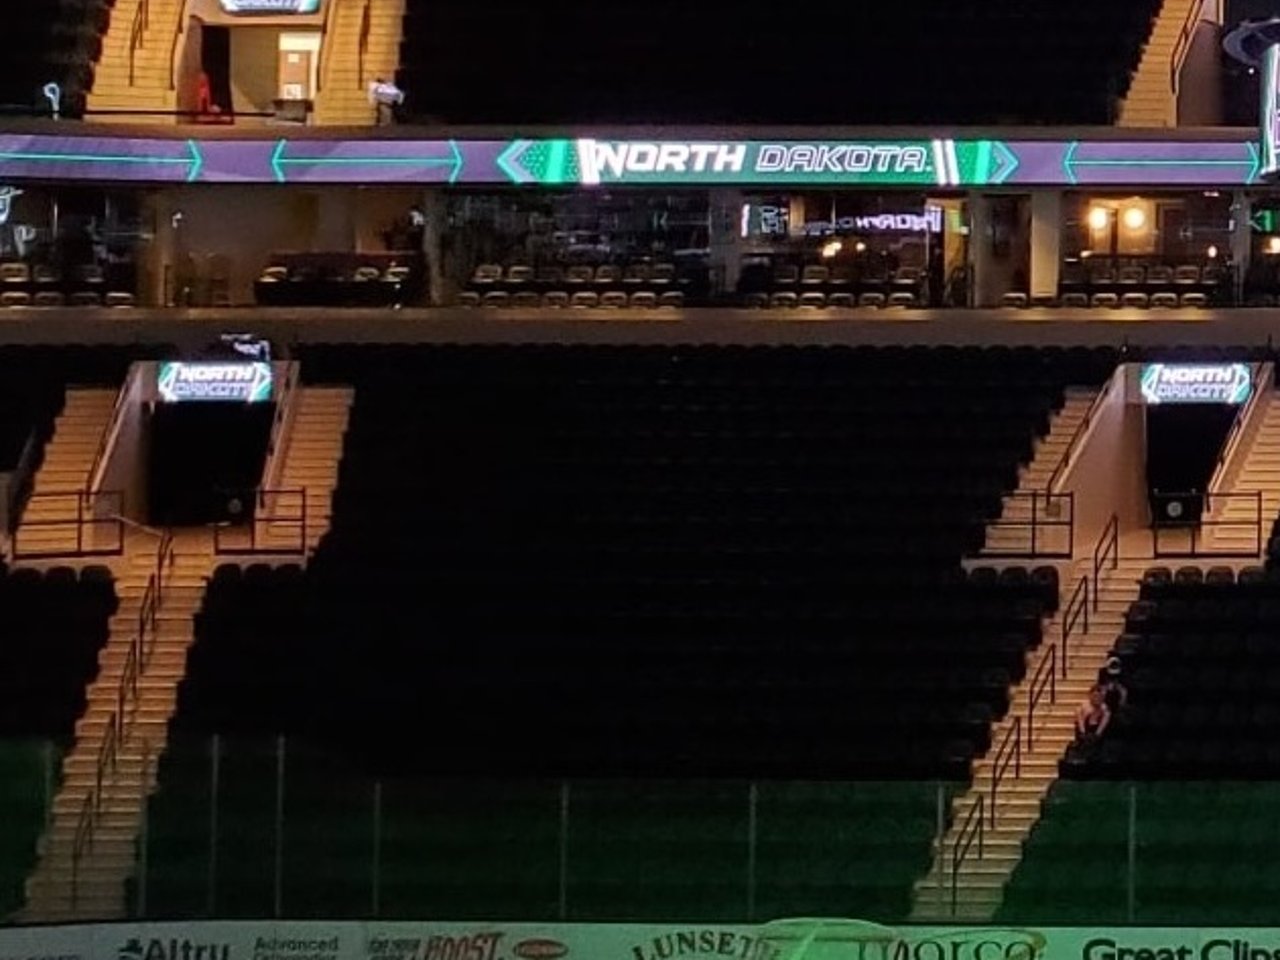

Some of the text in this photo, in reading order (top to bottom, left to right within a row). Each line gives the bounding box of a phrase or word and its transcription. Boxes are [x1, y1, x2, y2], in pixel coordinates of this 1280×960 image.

[594, 144, 746, 179] NORTH
[179, 366, 253, 383] NORTH
[1161, 368, 1233, 384] NORTH
[146, 939, 229, 960] Altru
[1082, 938, 1193, 960] Great
